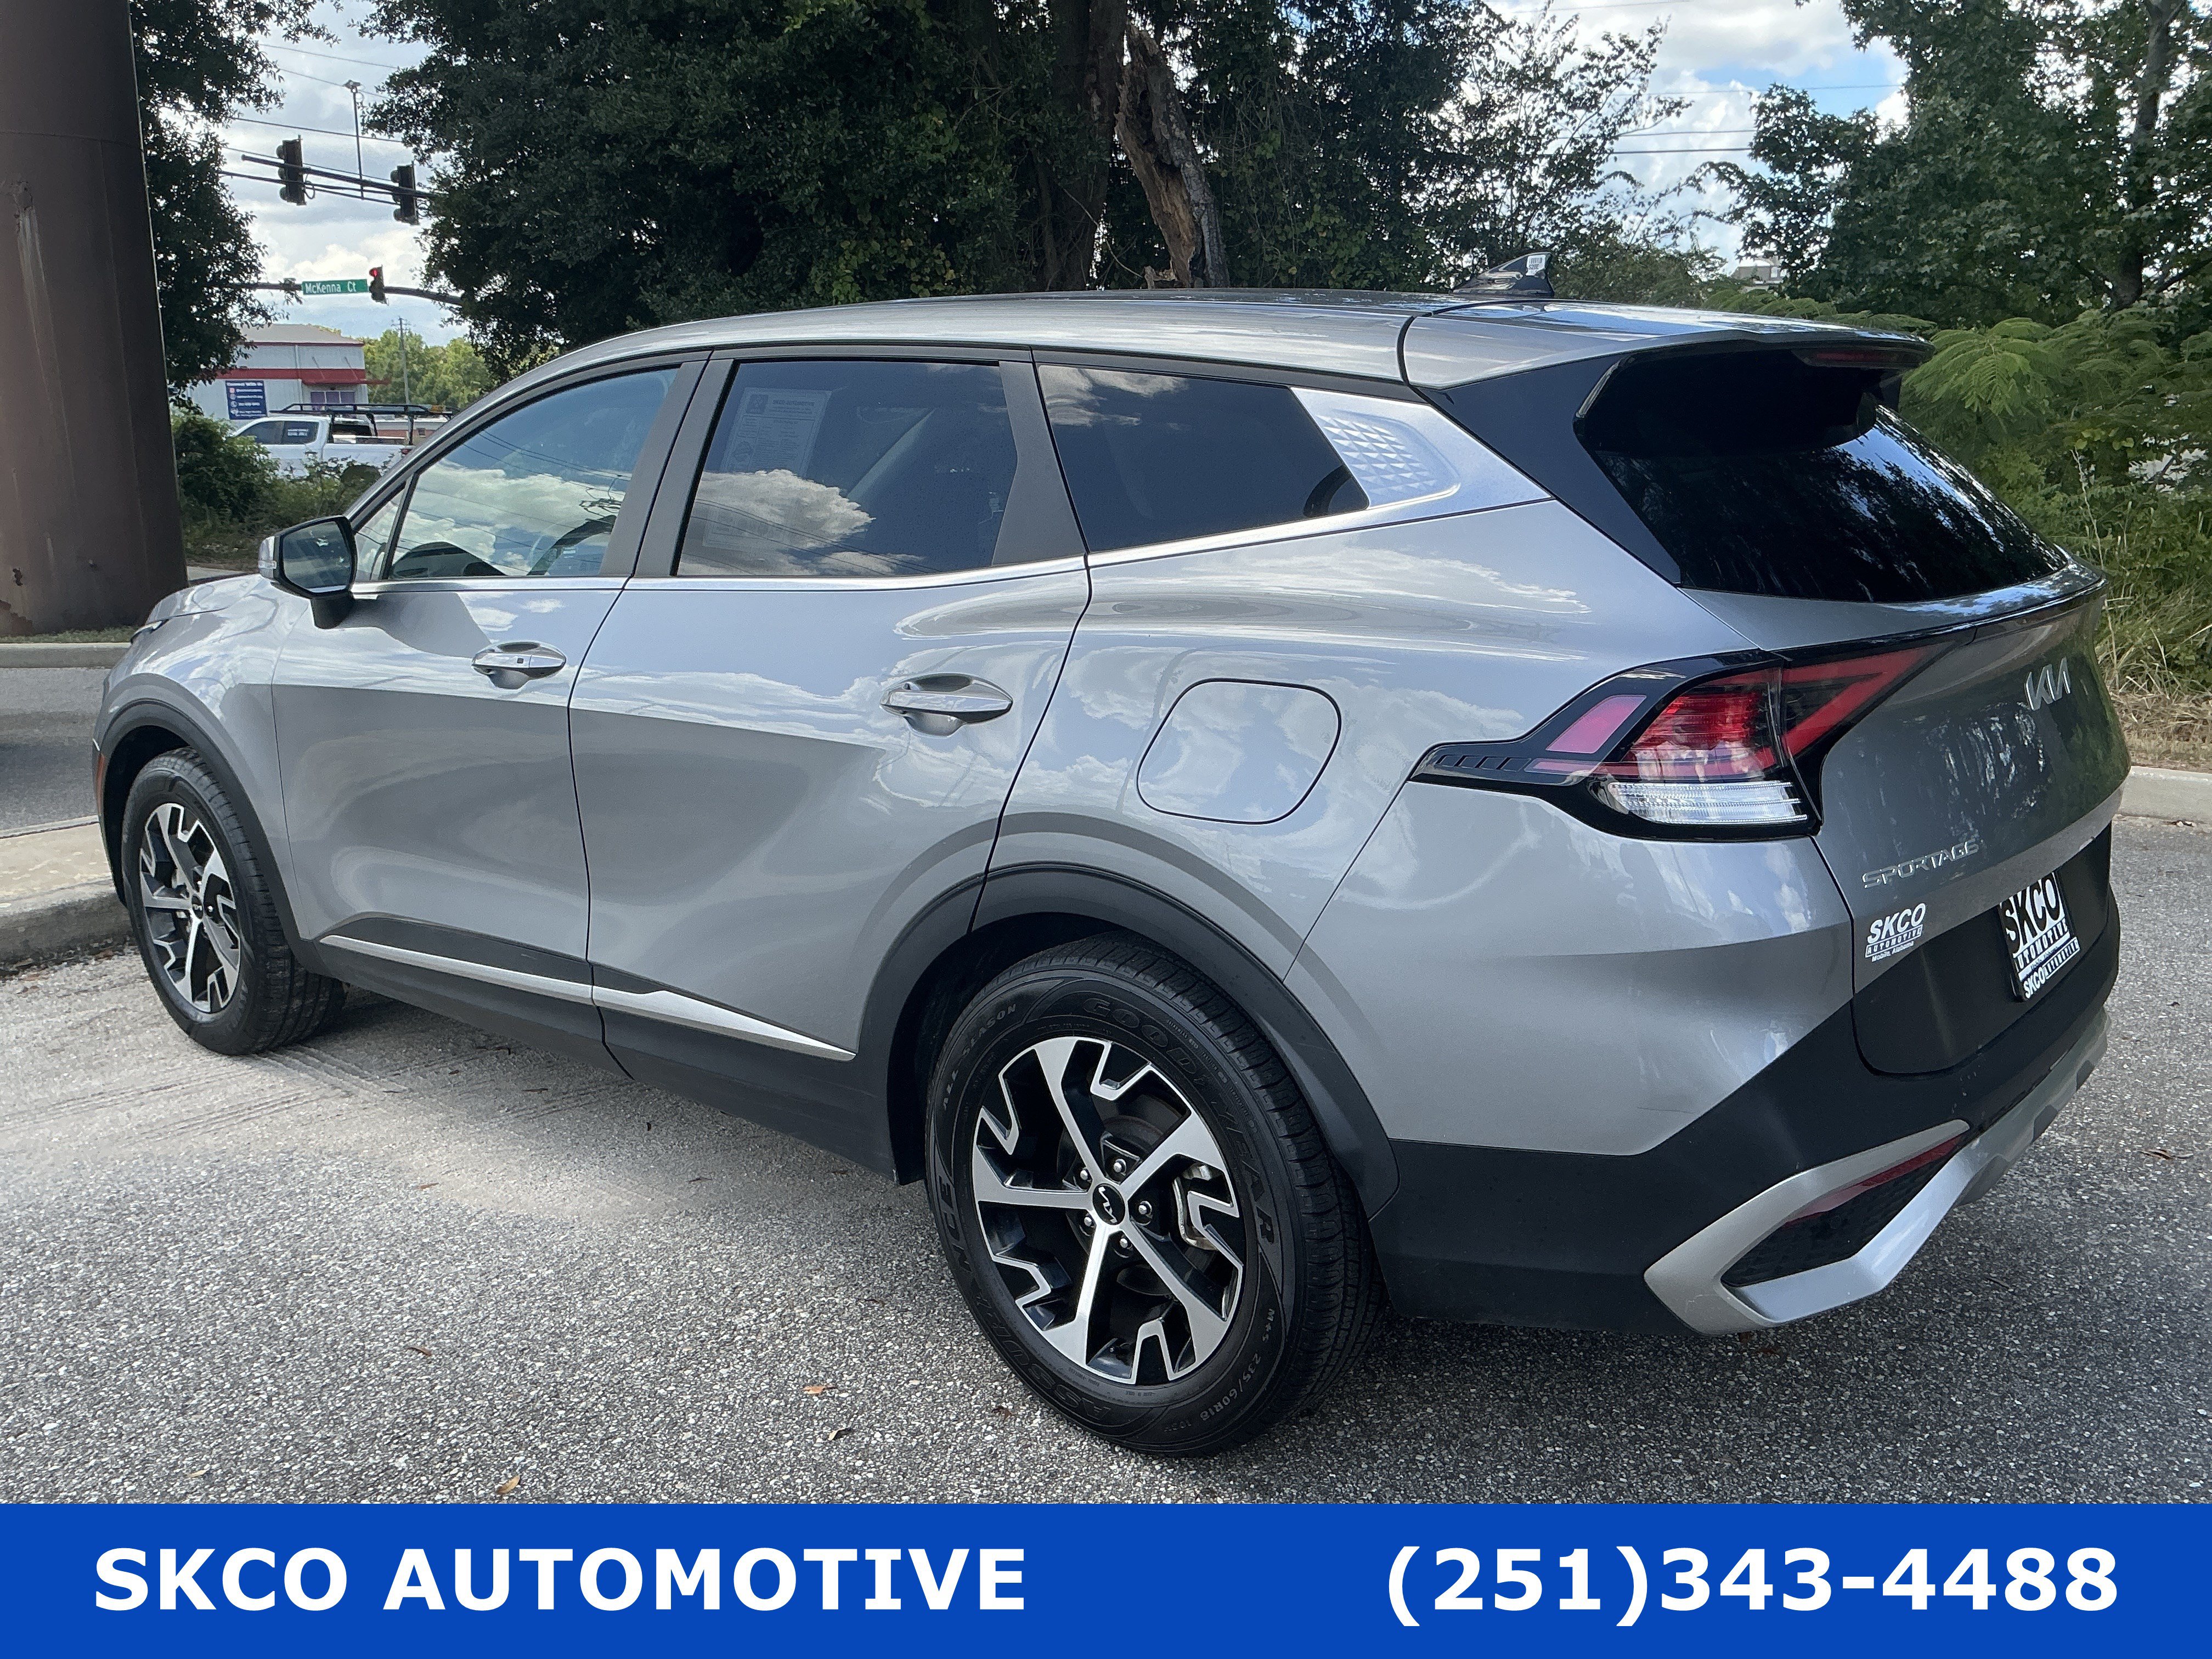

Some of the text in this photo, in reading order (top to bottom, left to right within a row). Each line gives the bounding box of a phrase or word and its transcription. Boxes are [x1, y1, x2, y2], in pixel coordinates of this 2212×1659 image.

[304, 281, 357, 294] McKenna Ct
[2023, 656, 2072, 712] KIA
[1861, 838, 1979, 889] SPORTAGE
[1866, 902, 1926, 944] SKCO
[1998, 874, 2062, 954] SKCO
[1867, 927, 1922, 955] AUTOMOTIVE
[2023, 965, 2046, 999] SKCO
[943, 1069, 959, 1111] ALL
[962, 1003, 1018, 1058] SEASON
[1199, 1352, 1261, 1421] 235/60R18
